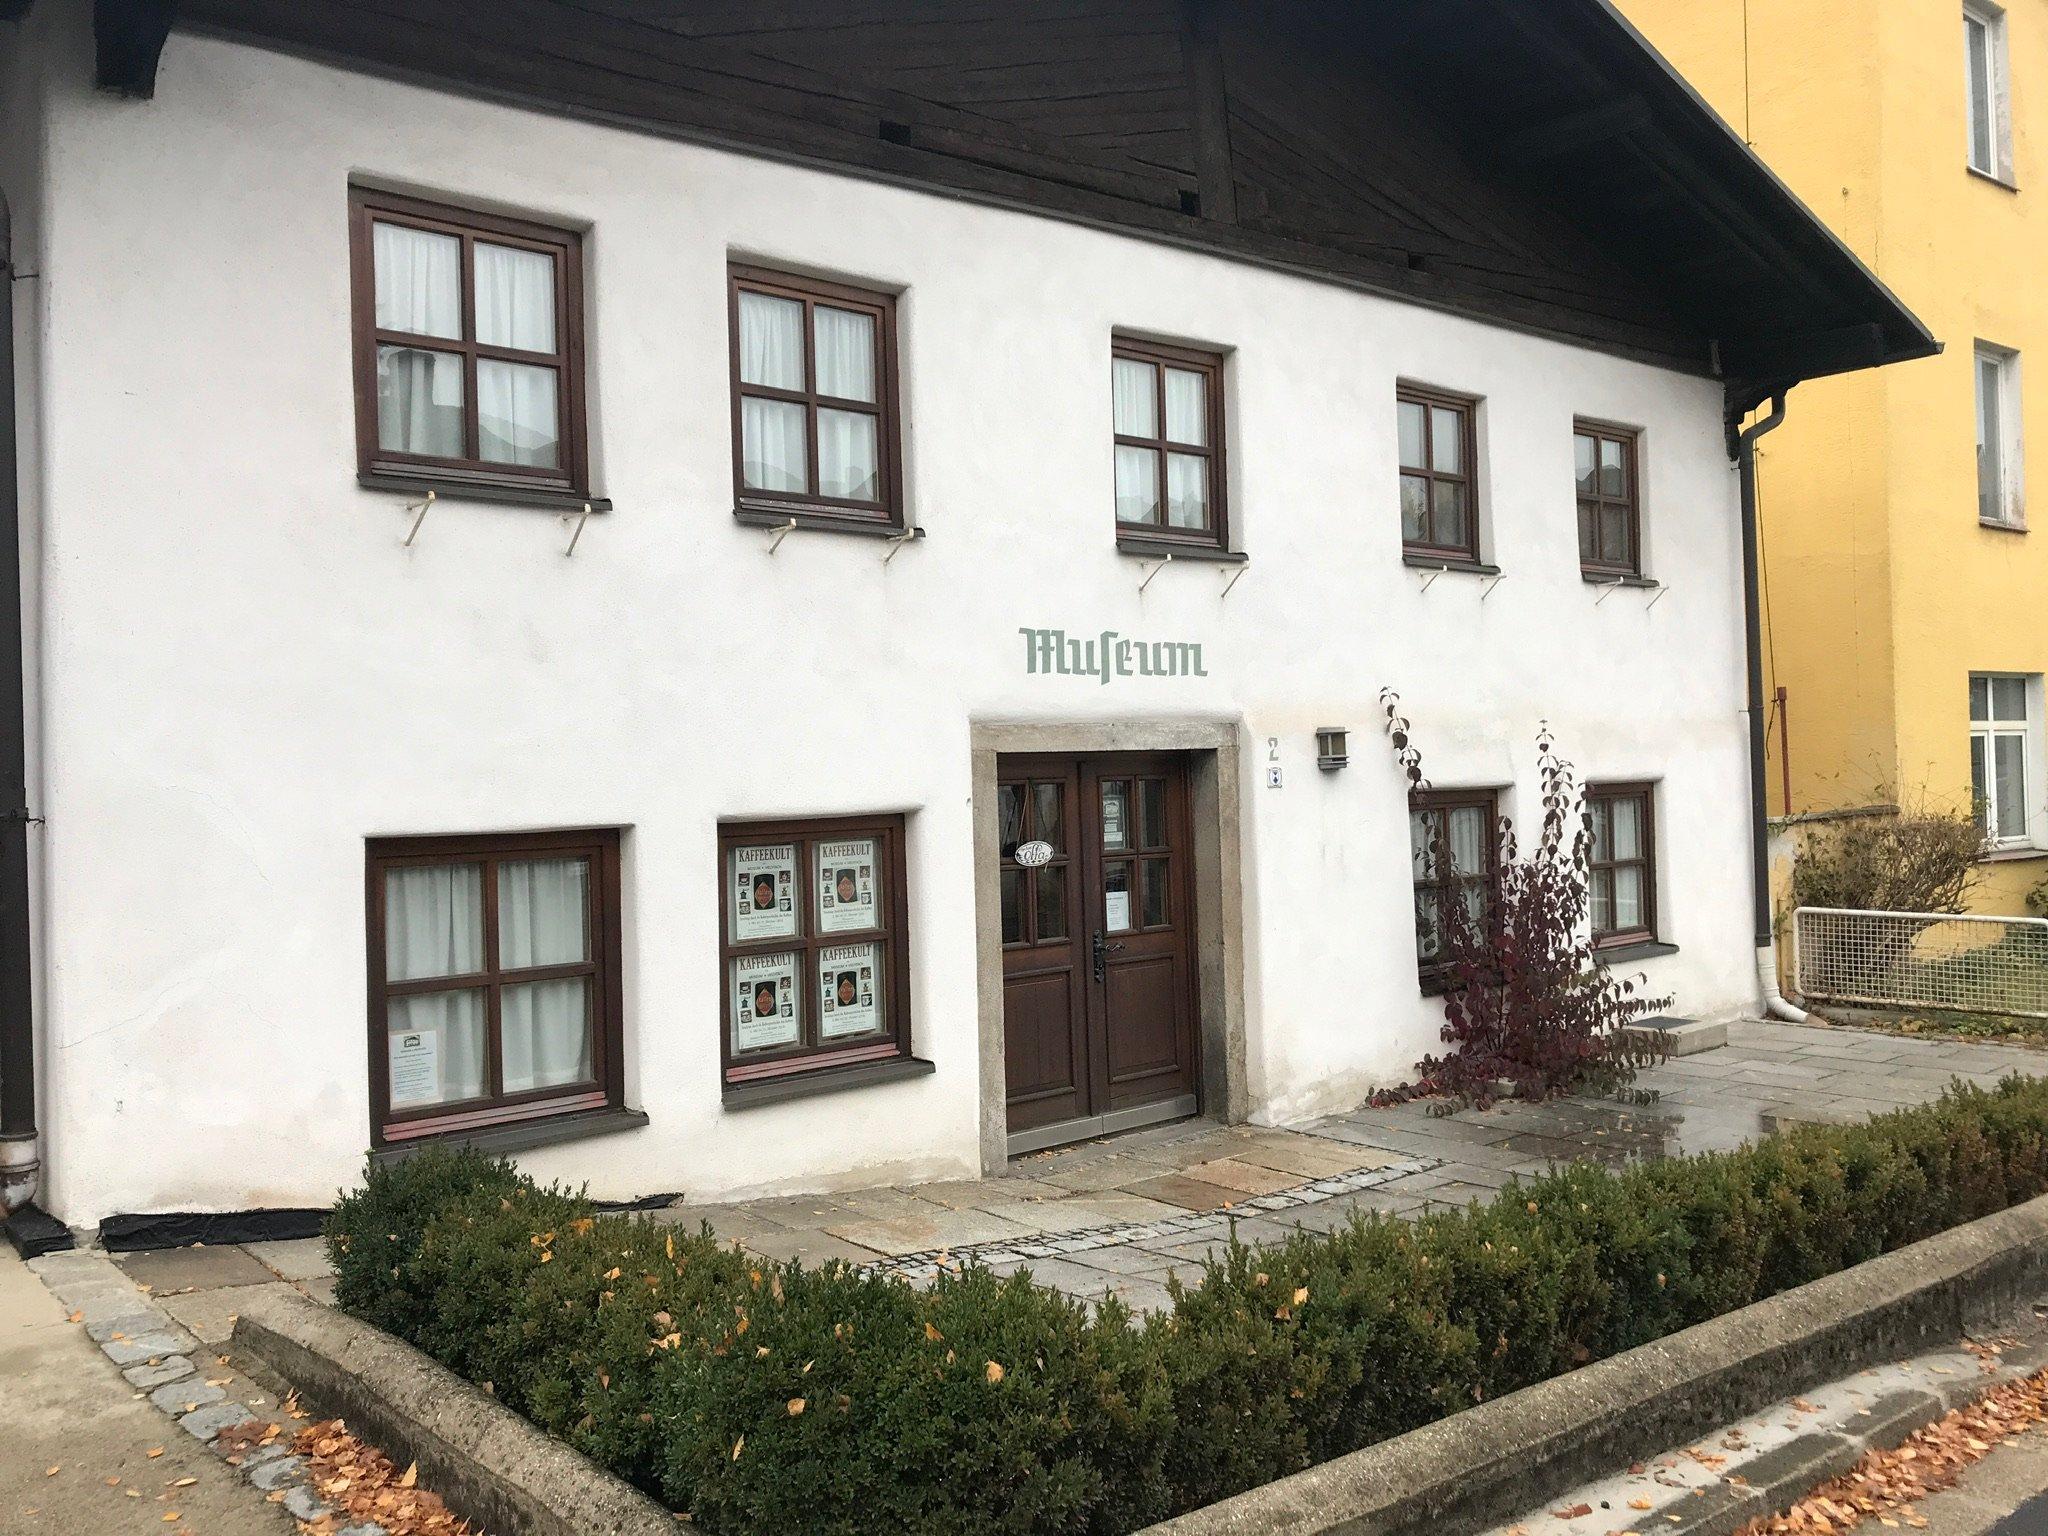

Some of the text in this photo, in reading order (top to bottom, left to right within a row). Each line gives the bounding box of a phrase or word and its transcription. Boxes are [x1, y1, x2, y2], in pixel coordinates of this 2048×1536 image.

[1267, 737, 1279, 761] 2
[739, 848, 791, 862] KAFFEEKULT
[822, 844, 871, 858] KAFFEEKULT
[822, 945, 871, 962] KAFFEEKULT
[739, 955, 791, 971] KAFFEEKULT
